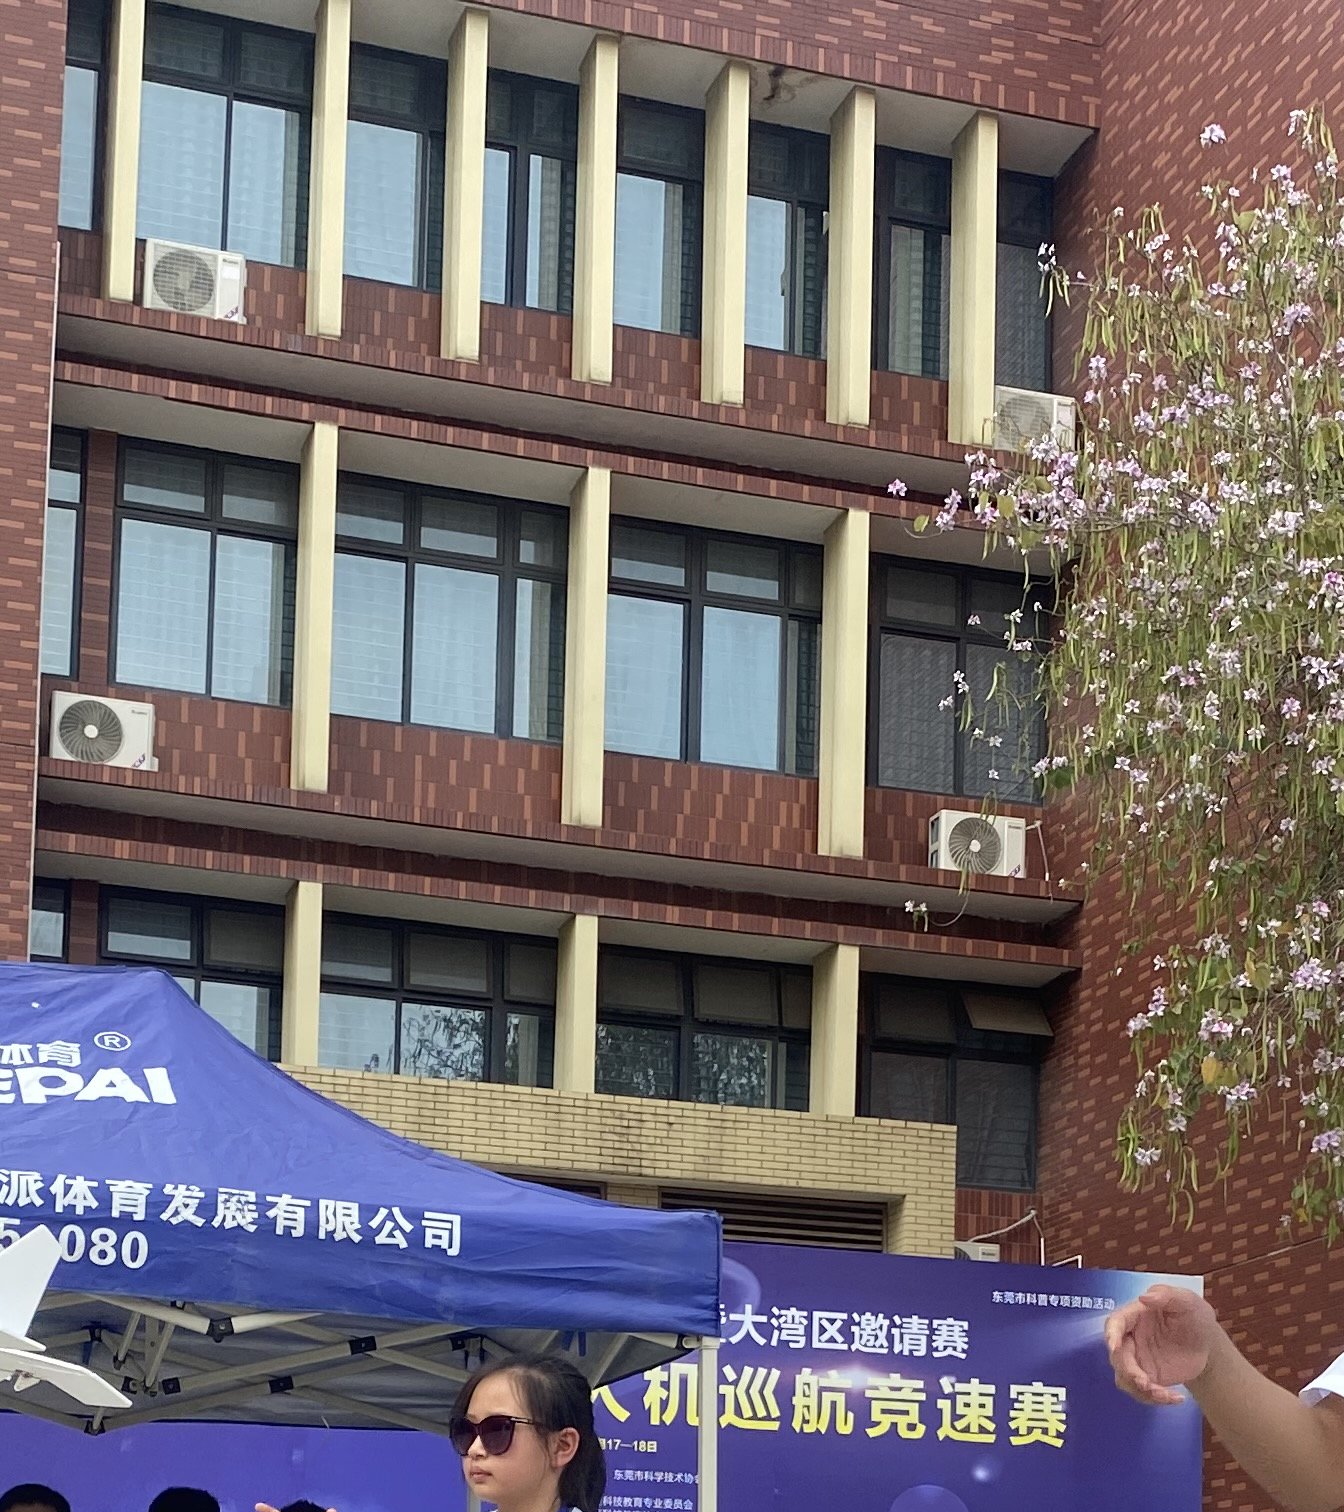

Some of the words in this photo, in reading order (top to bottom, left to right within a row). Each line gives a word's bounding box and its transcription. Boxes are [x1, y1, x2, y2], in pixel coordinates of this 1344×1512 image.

[992, 1290, 1115, 1310] 东莞市科普专项资助活动
[720, 1303, 969, 1360] 大湾区邀请赛
[599, 1495, 694, 1510] 科技教育专业委员会
